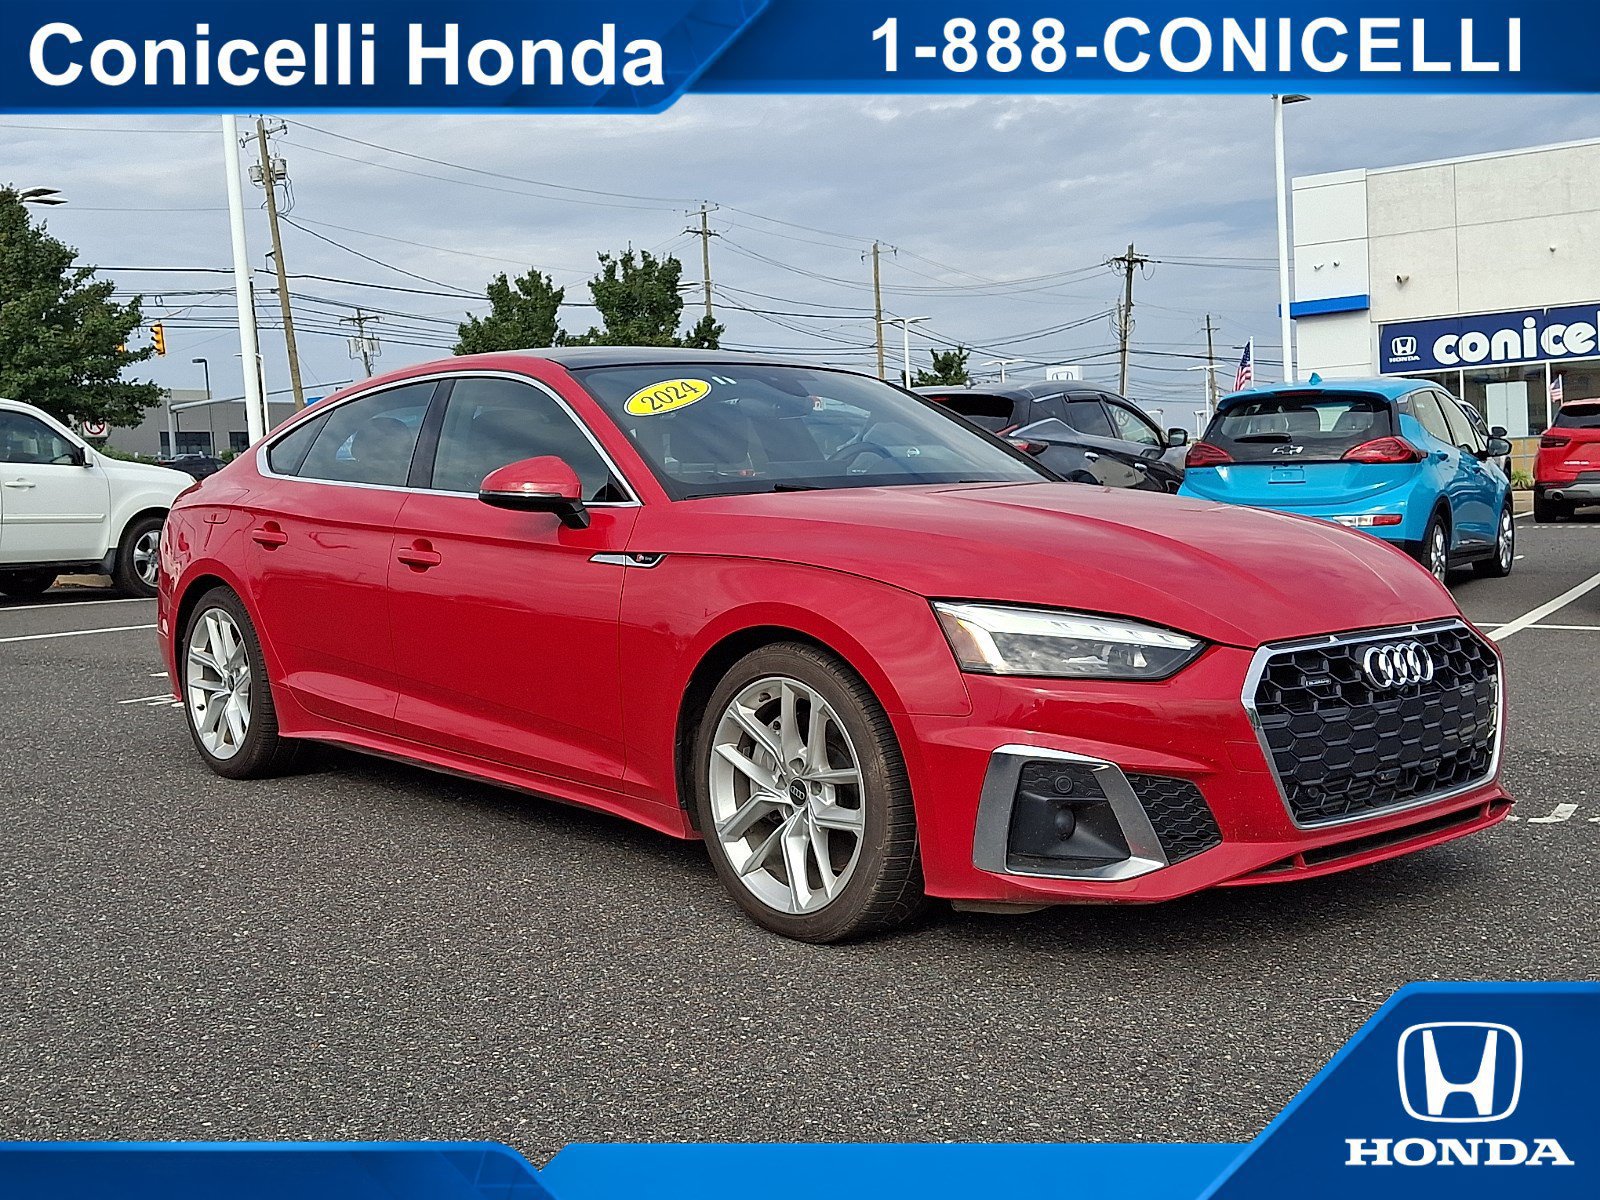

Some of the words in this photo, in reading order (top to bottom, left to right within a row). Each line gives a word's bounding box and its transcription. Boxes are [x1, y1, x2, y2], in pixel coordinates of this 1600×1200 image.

[1433, 311, 1600, 365] conice
[1389, 355, 1420, 363] HONDA
[641, 382, 699, 410] 2024
